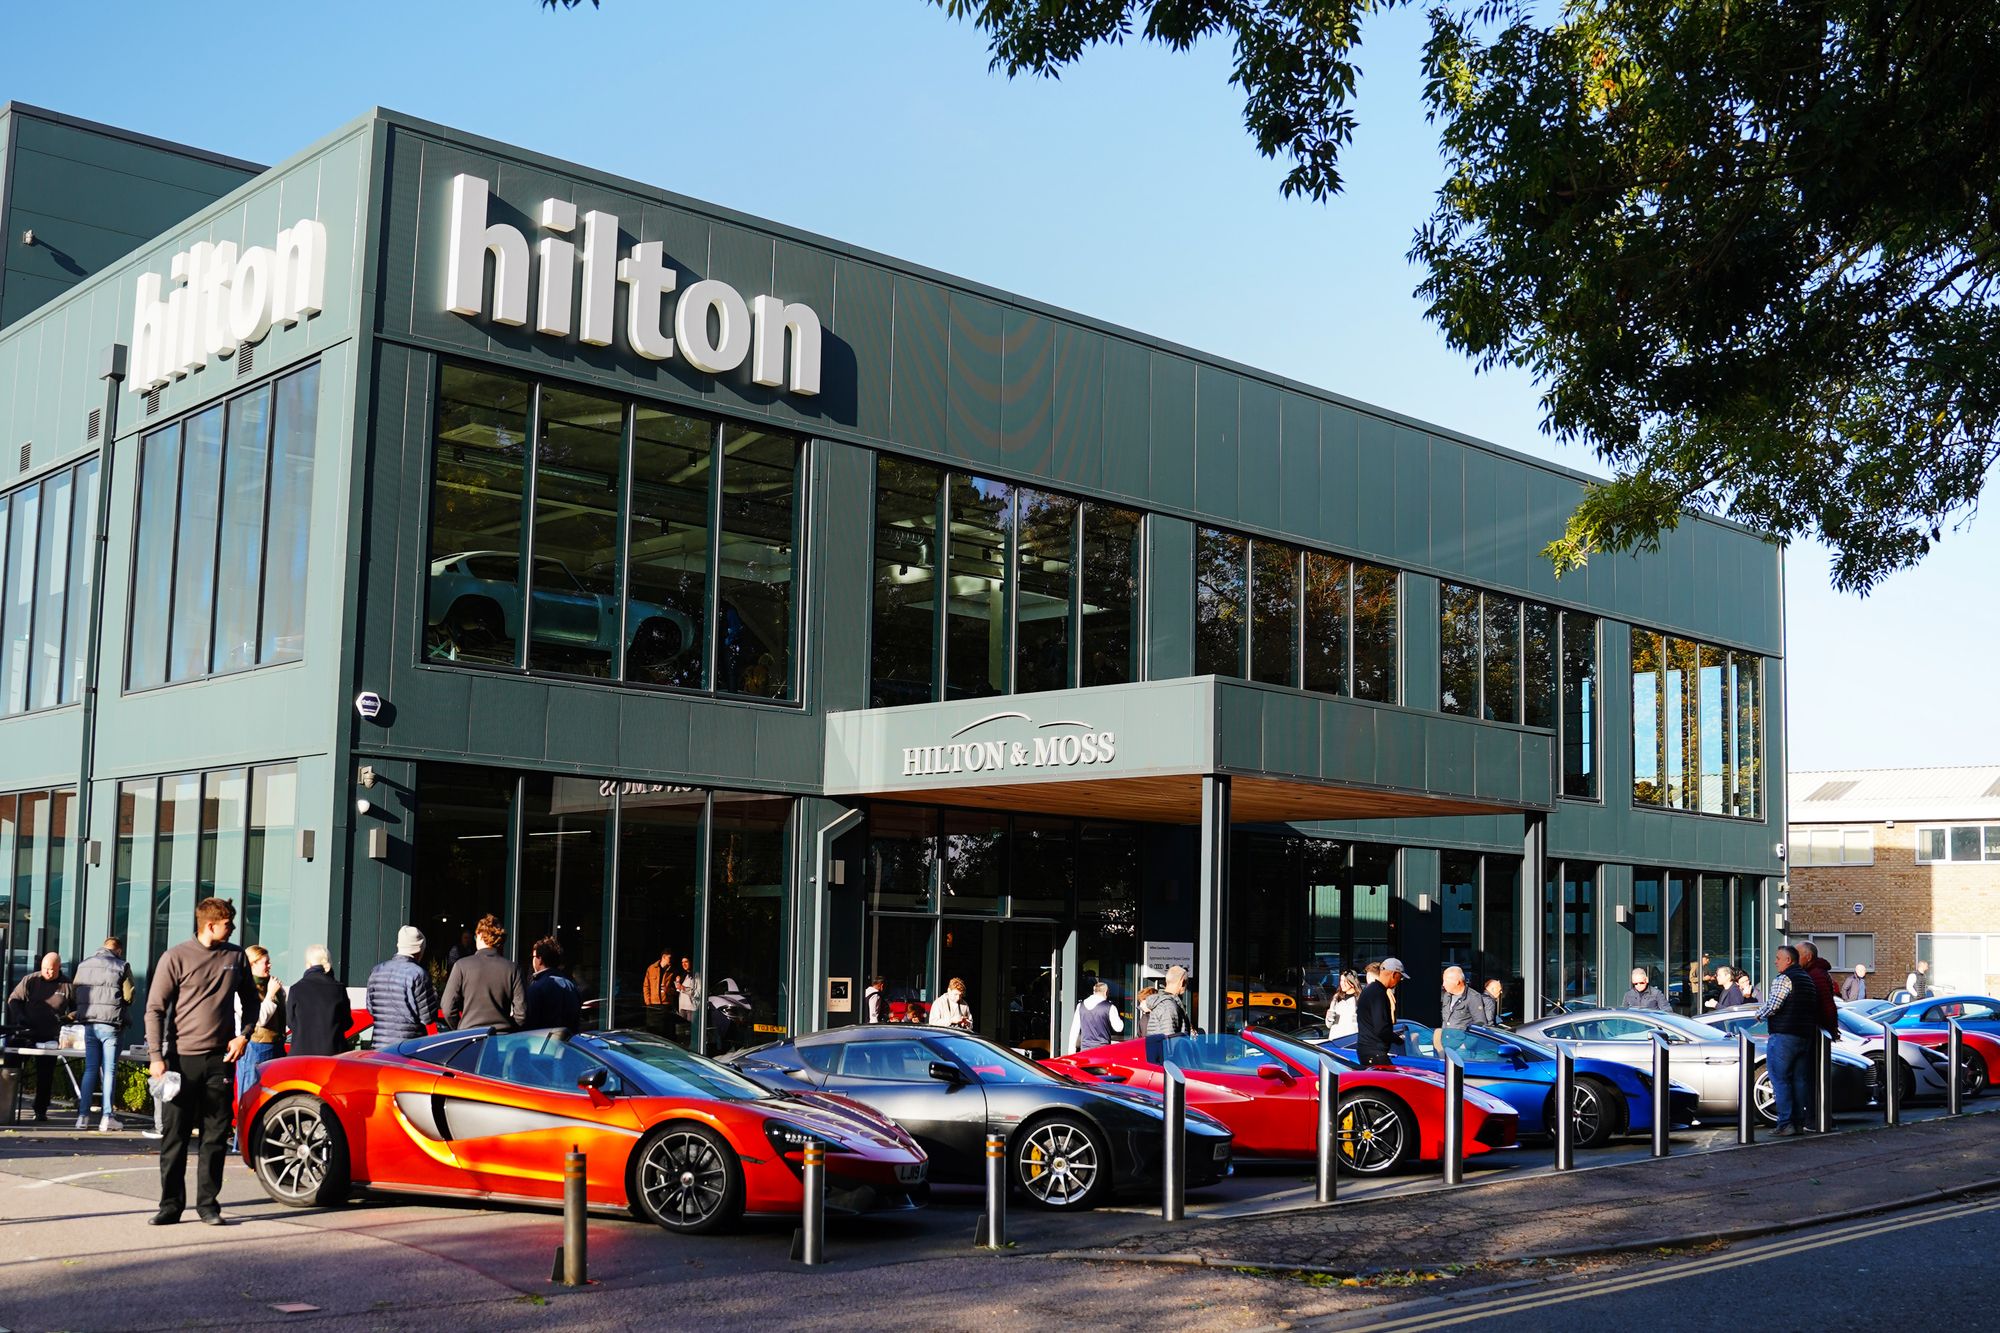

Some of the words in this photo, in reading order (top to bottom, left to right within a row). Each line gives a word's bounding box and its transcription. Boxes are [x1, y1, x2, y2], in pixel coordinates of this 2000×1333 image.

[129, 218, 327, 395] hilton
[446, 173, 822, 396] hilton
[902, 740, 1007, 775] HILTON
[1010, 741, 1028, 766] &
[1033, 731, 1115, 767] MOSS
